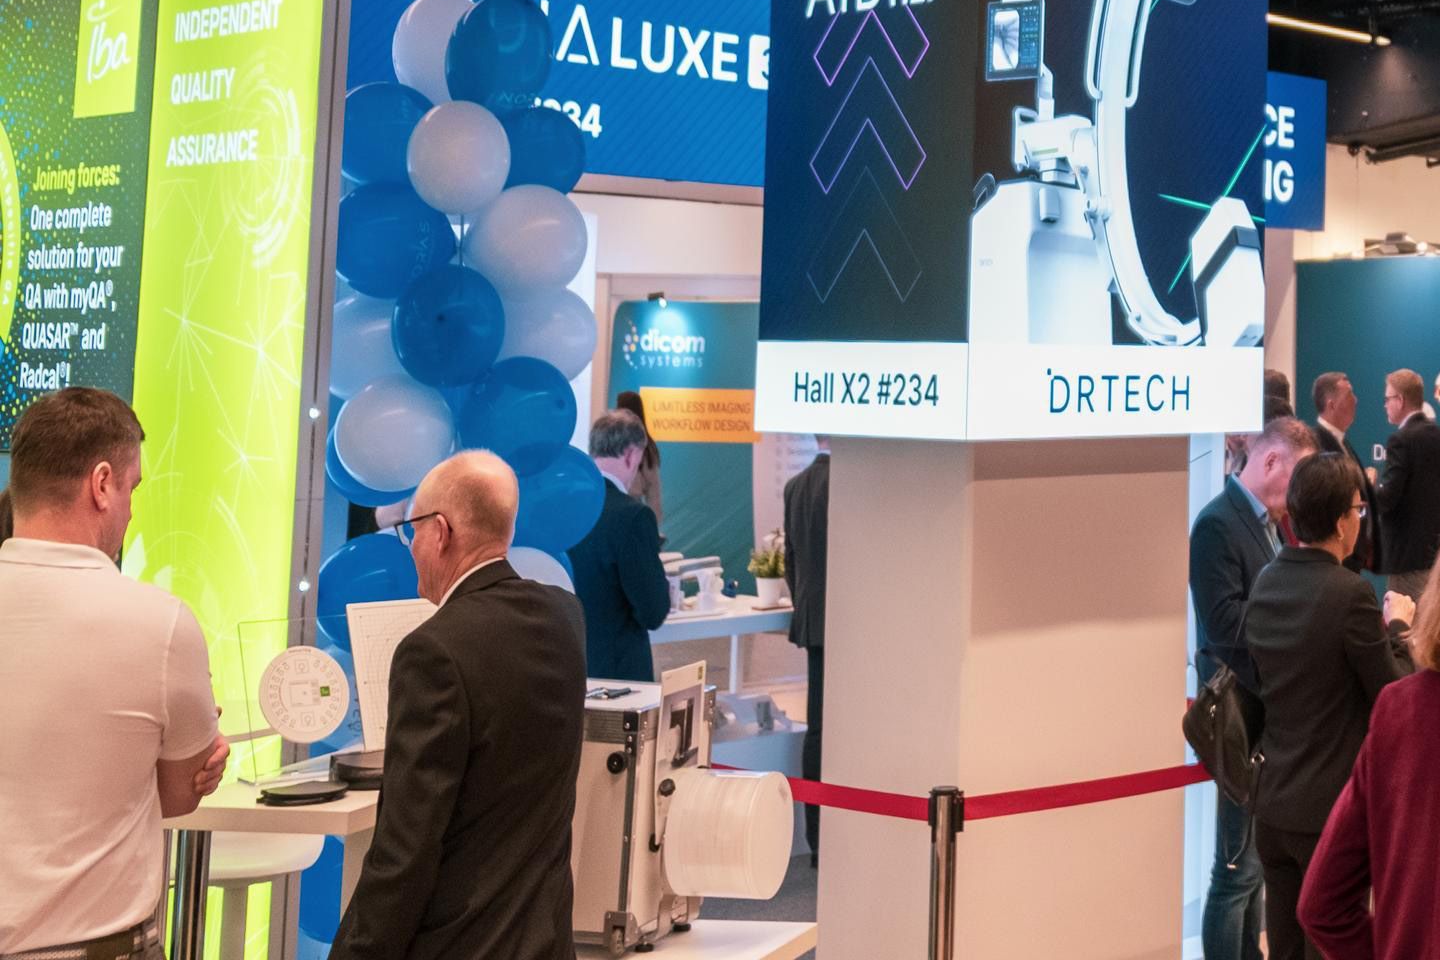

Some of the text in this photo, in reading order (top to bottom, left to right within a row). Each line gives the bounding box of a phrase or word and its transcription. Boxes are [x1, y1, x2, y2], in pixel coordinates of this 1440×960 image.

[611, 17, 739, 82] LUXE
[170, 68, 235, 106] QUALITY
[166, 129, 258, 168] ASSURANCE
[33, 162, 121, 194] Joining forces:
[30, 201, 112, 233] One complete
[27, 241, 124, 273] solution for your
[25, 283, 42, 310] QA
[43, 282, 69, 309] with
[81, 322, 106, 350] and
[640, 328, 705, 353] dicom
[640, 354, 703, 368] systems
[794, 371, 939, 407] Hall X2 #234
[1047, 368, 1190, 413] DRTECH
[653, 401, 751, 414] LIMITLESS IMAGING
[653, 419, 750, 432] WORKFLOW DESIGN
